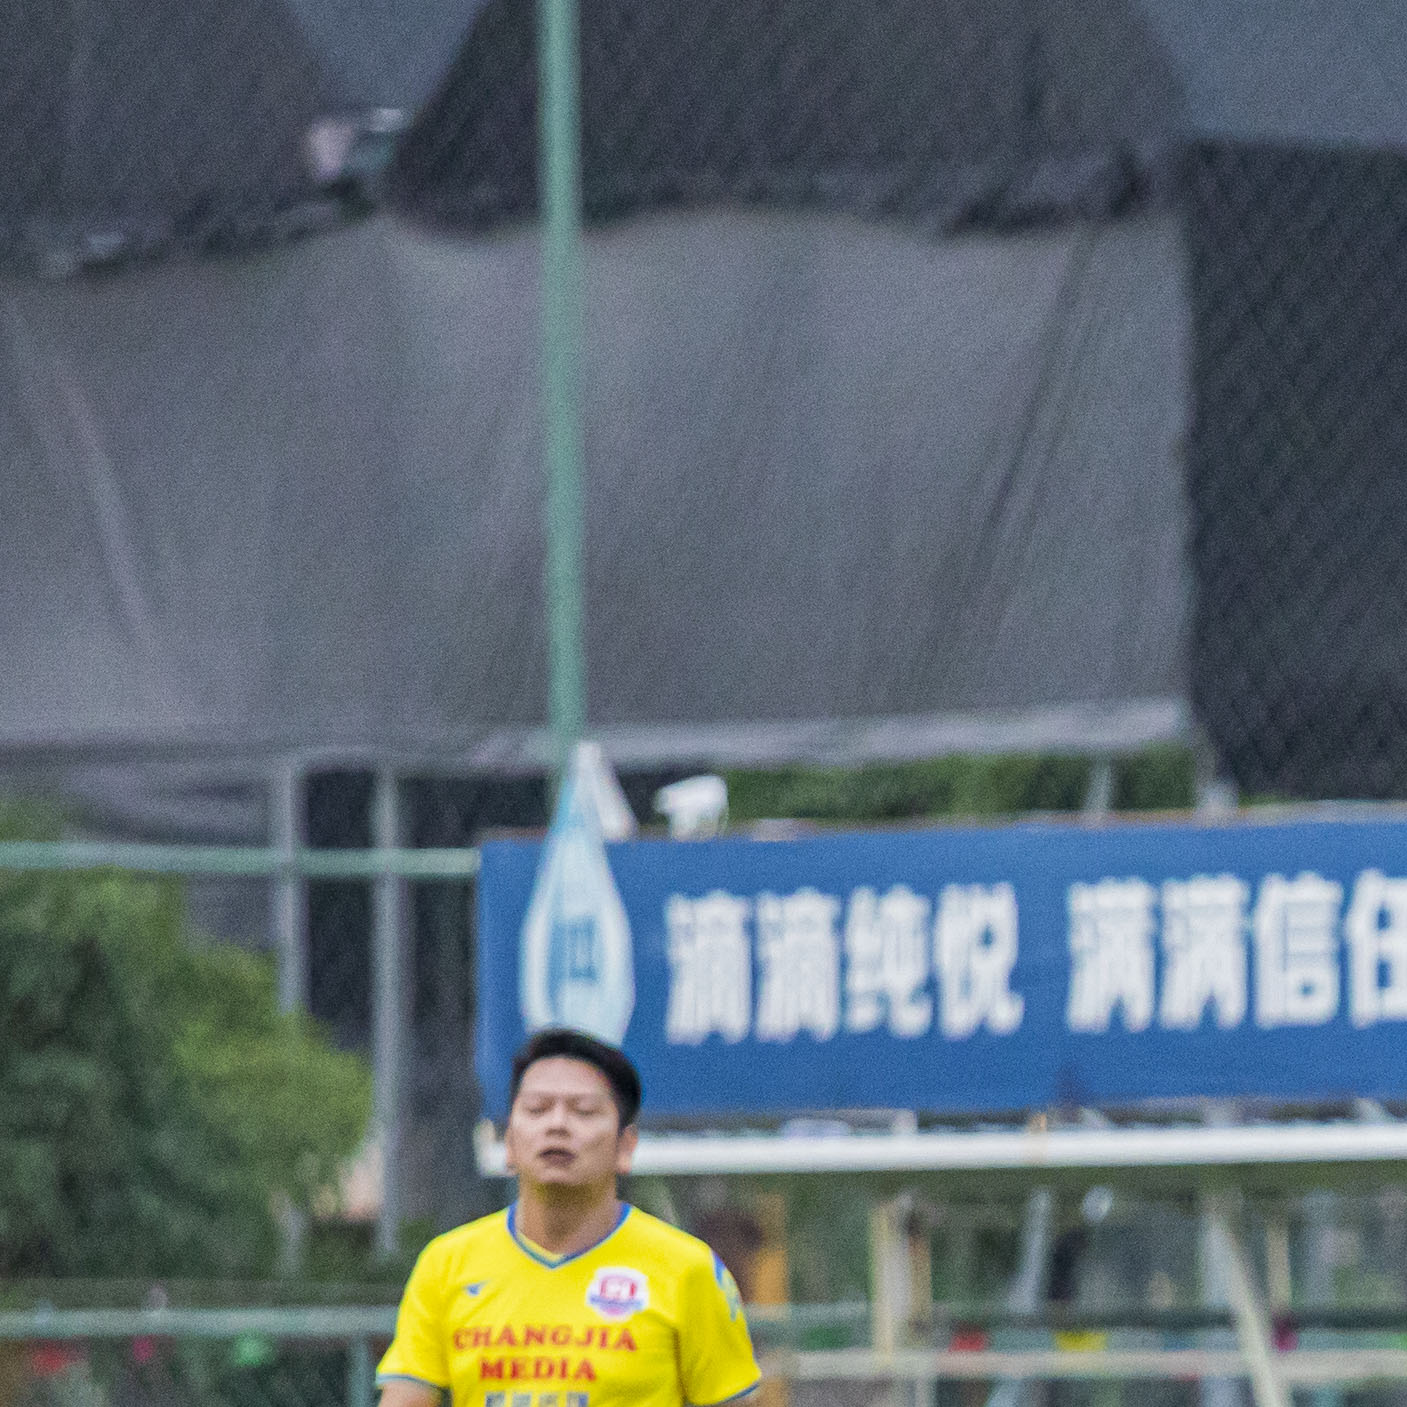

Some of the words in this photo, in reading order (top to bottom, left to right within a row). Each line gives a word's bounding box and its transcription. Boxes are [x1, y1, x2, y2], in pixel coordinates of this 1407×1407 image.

[665, 883, 1024, 1044] 滴滴纯悦
[453, 1323, 638, 1352] CHANGJIA
[479, 1355, 597, 1381] MEDIA
